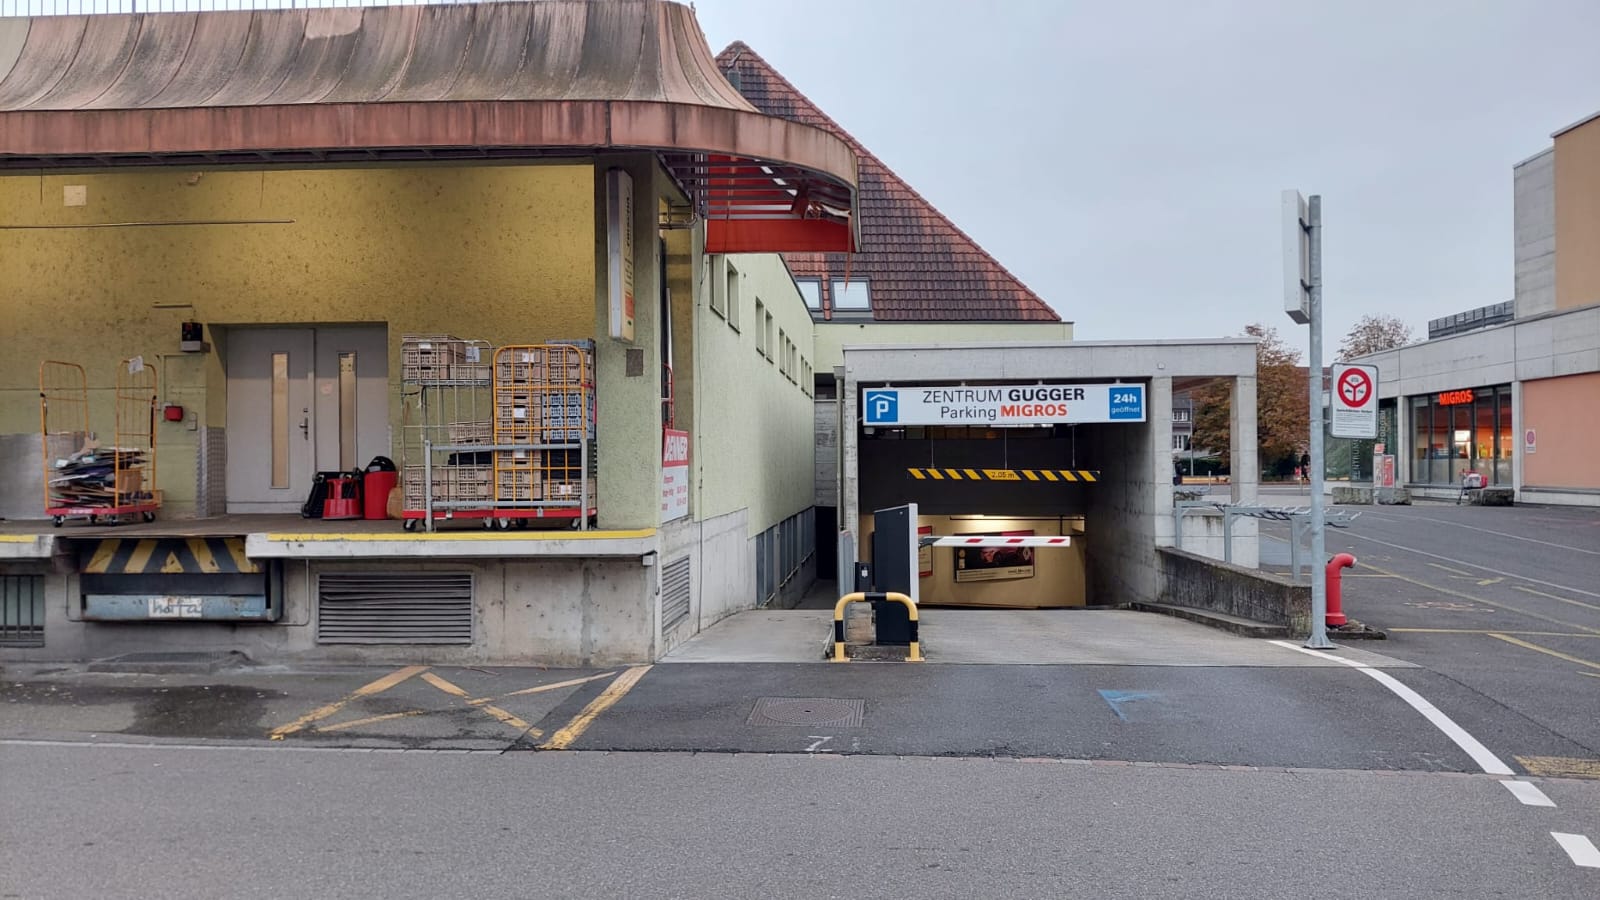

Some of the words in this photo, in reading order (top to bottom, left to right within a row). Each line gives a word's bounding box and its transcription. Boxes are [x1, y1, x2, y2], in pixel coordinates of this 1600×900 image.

[923, 390, 1002, 403] ZENTRUM
[1008, 388, 1085, 402] GUGGER
[1113, 393, 1137, 404] 24h
[1439, 391, 1474, 405] MIGROS
[876, 400, 889, 419] P
[941, 406, 997, 421] Parking
[1000, 404, 1068, 417] MIGROS
[1111, 406, 1140, 415] geöffnet
